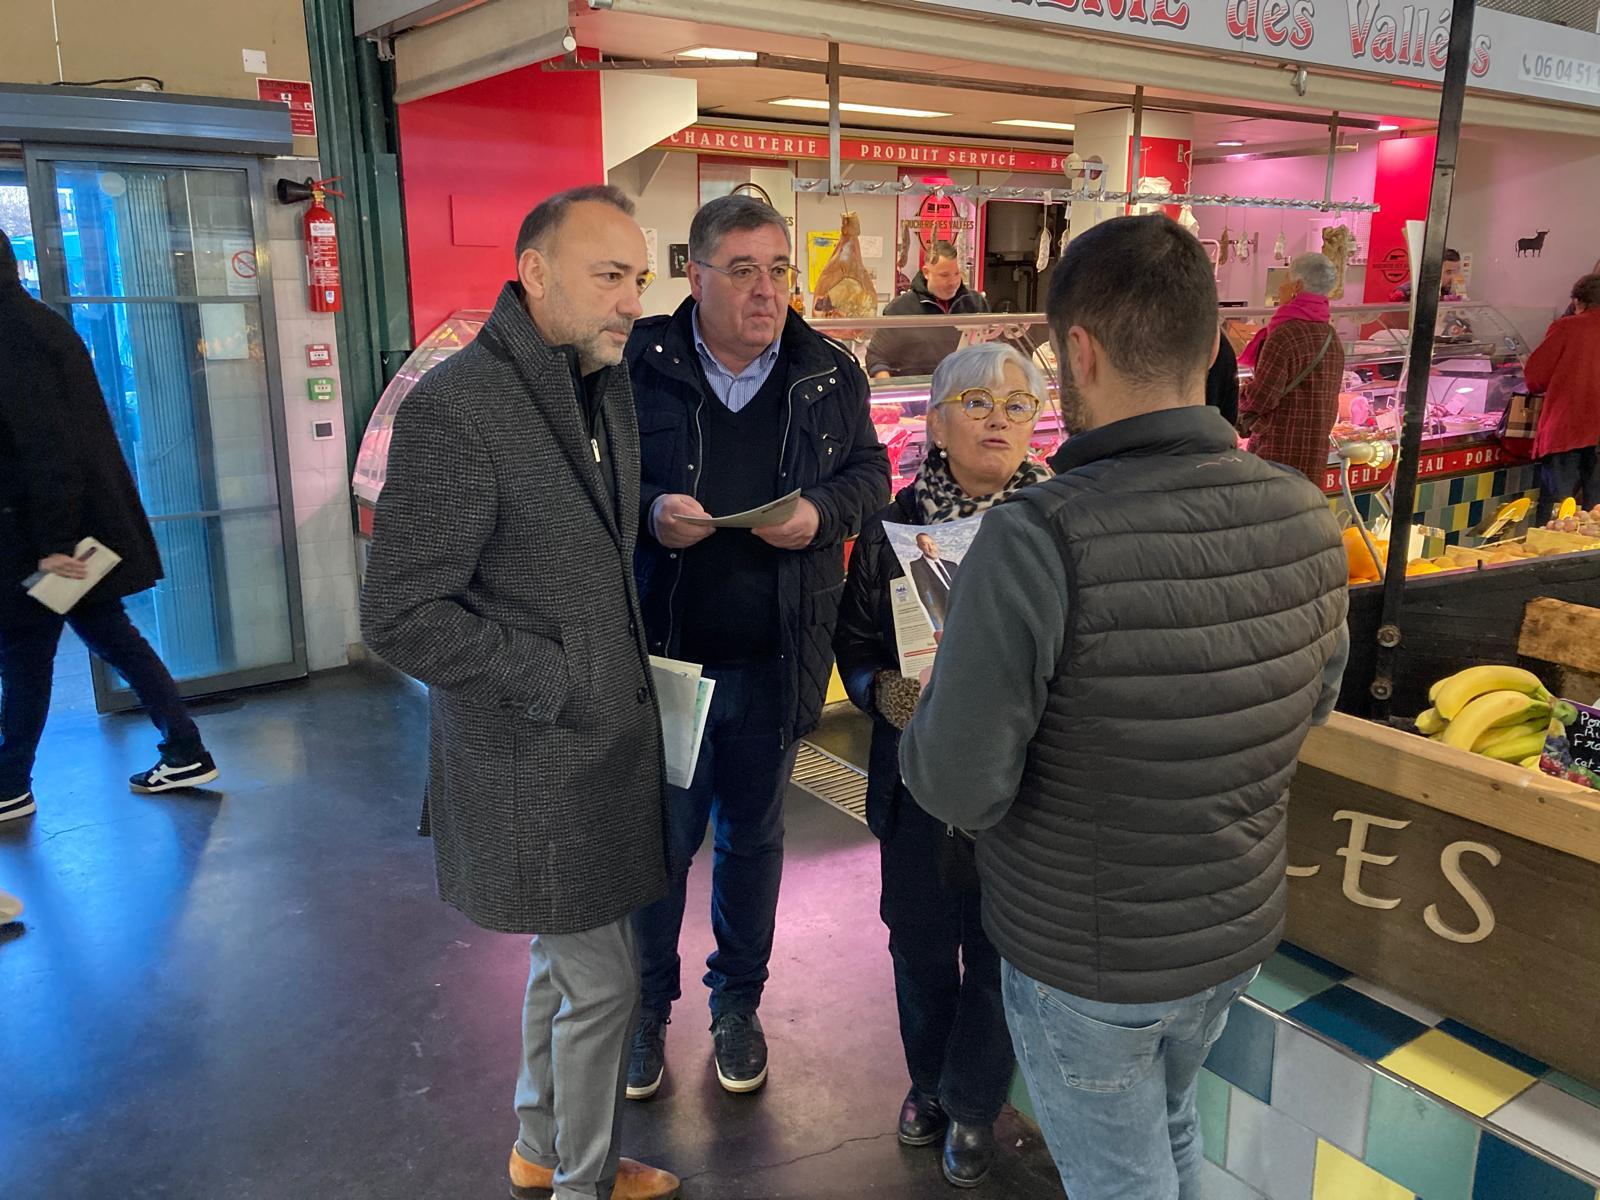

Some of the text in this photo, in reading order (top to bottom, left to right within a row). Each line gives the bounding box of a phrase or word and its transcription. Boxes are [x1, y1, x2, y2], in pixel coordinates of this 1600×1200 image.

[1225, 0, 1315, 48] des
[1347, 0, 1493, 78] Vallés
[1535, 54, 1553, 78] 06
[1556, 59, 1573, 82] 04
[670, 131, 816, 154] CHARCUTERIE
[860, 144, 940, 161] PRODUIT
[948, 151, 1016, 166] SERVICE
